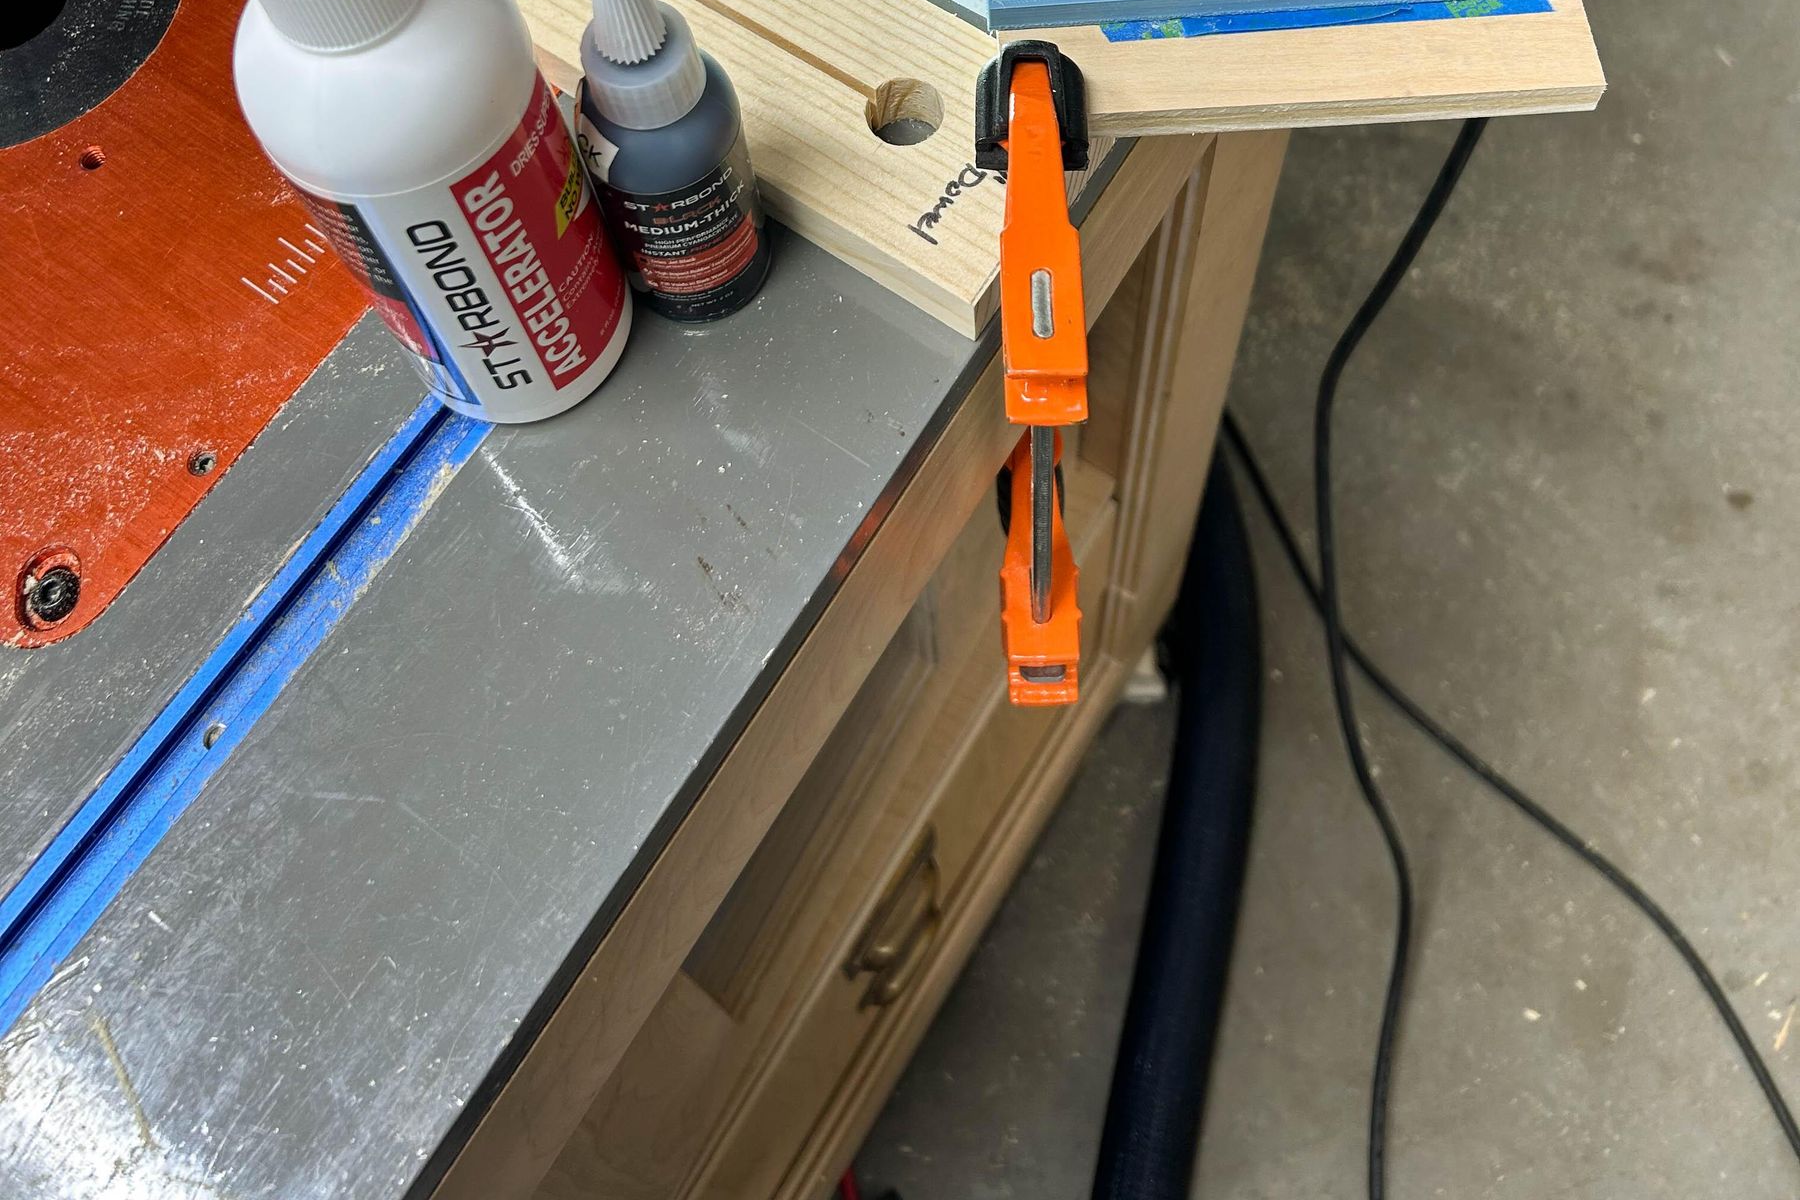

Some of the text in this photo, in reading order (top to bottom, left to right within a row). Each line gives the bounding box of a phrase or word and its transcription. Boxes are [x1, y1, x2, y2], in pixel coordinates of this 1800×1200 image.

[510, 130, 541, 178] DRIES
[576, 133, 602, 168] CK
[623, 166, 733, 213] STARBOND
[624, 179, 745, 236] MEDIUM-THICK
[907, 162, 987, 245] Dowel
[641, 248, 687, 257] INSTANT
[644, 242, 682, 250] PREMIUM
[464, 170, 587, 376] ACCELERATOR
[406, 219, 534, 390] STARBOND
